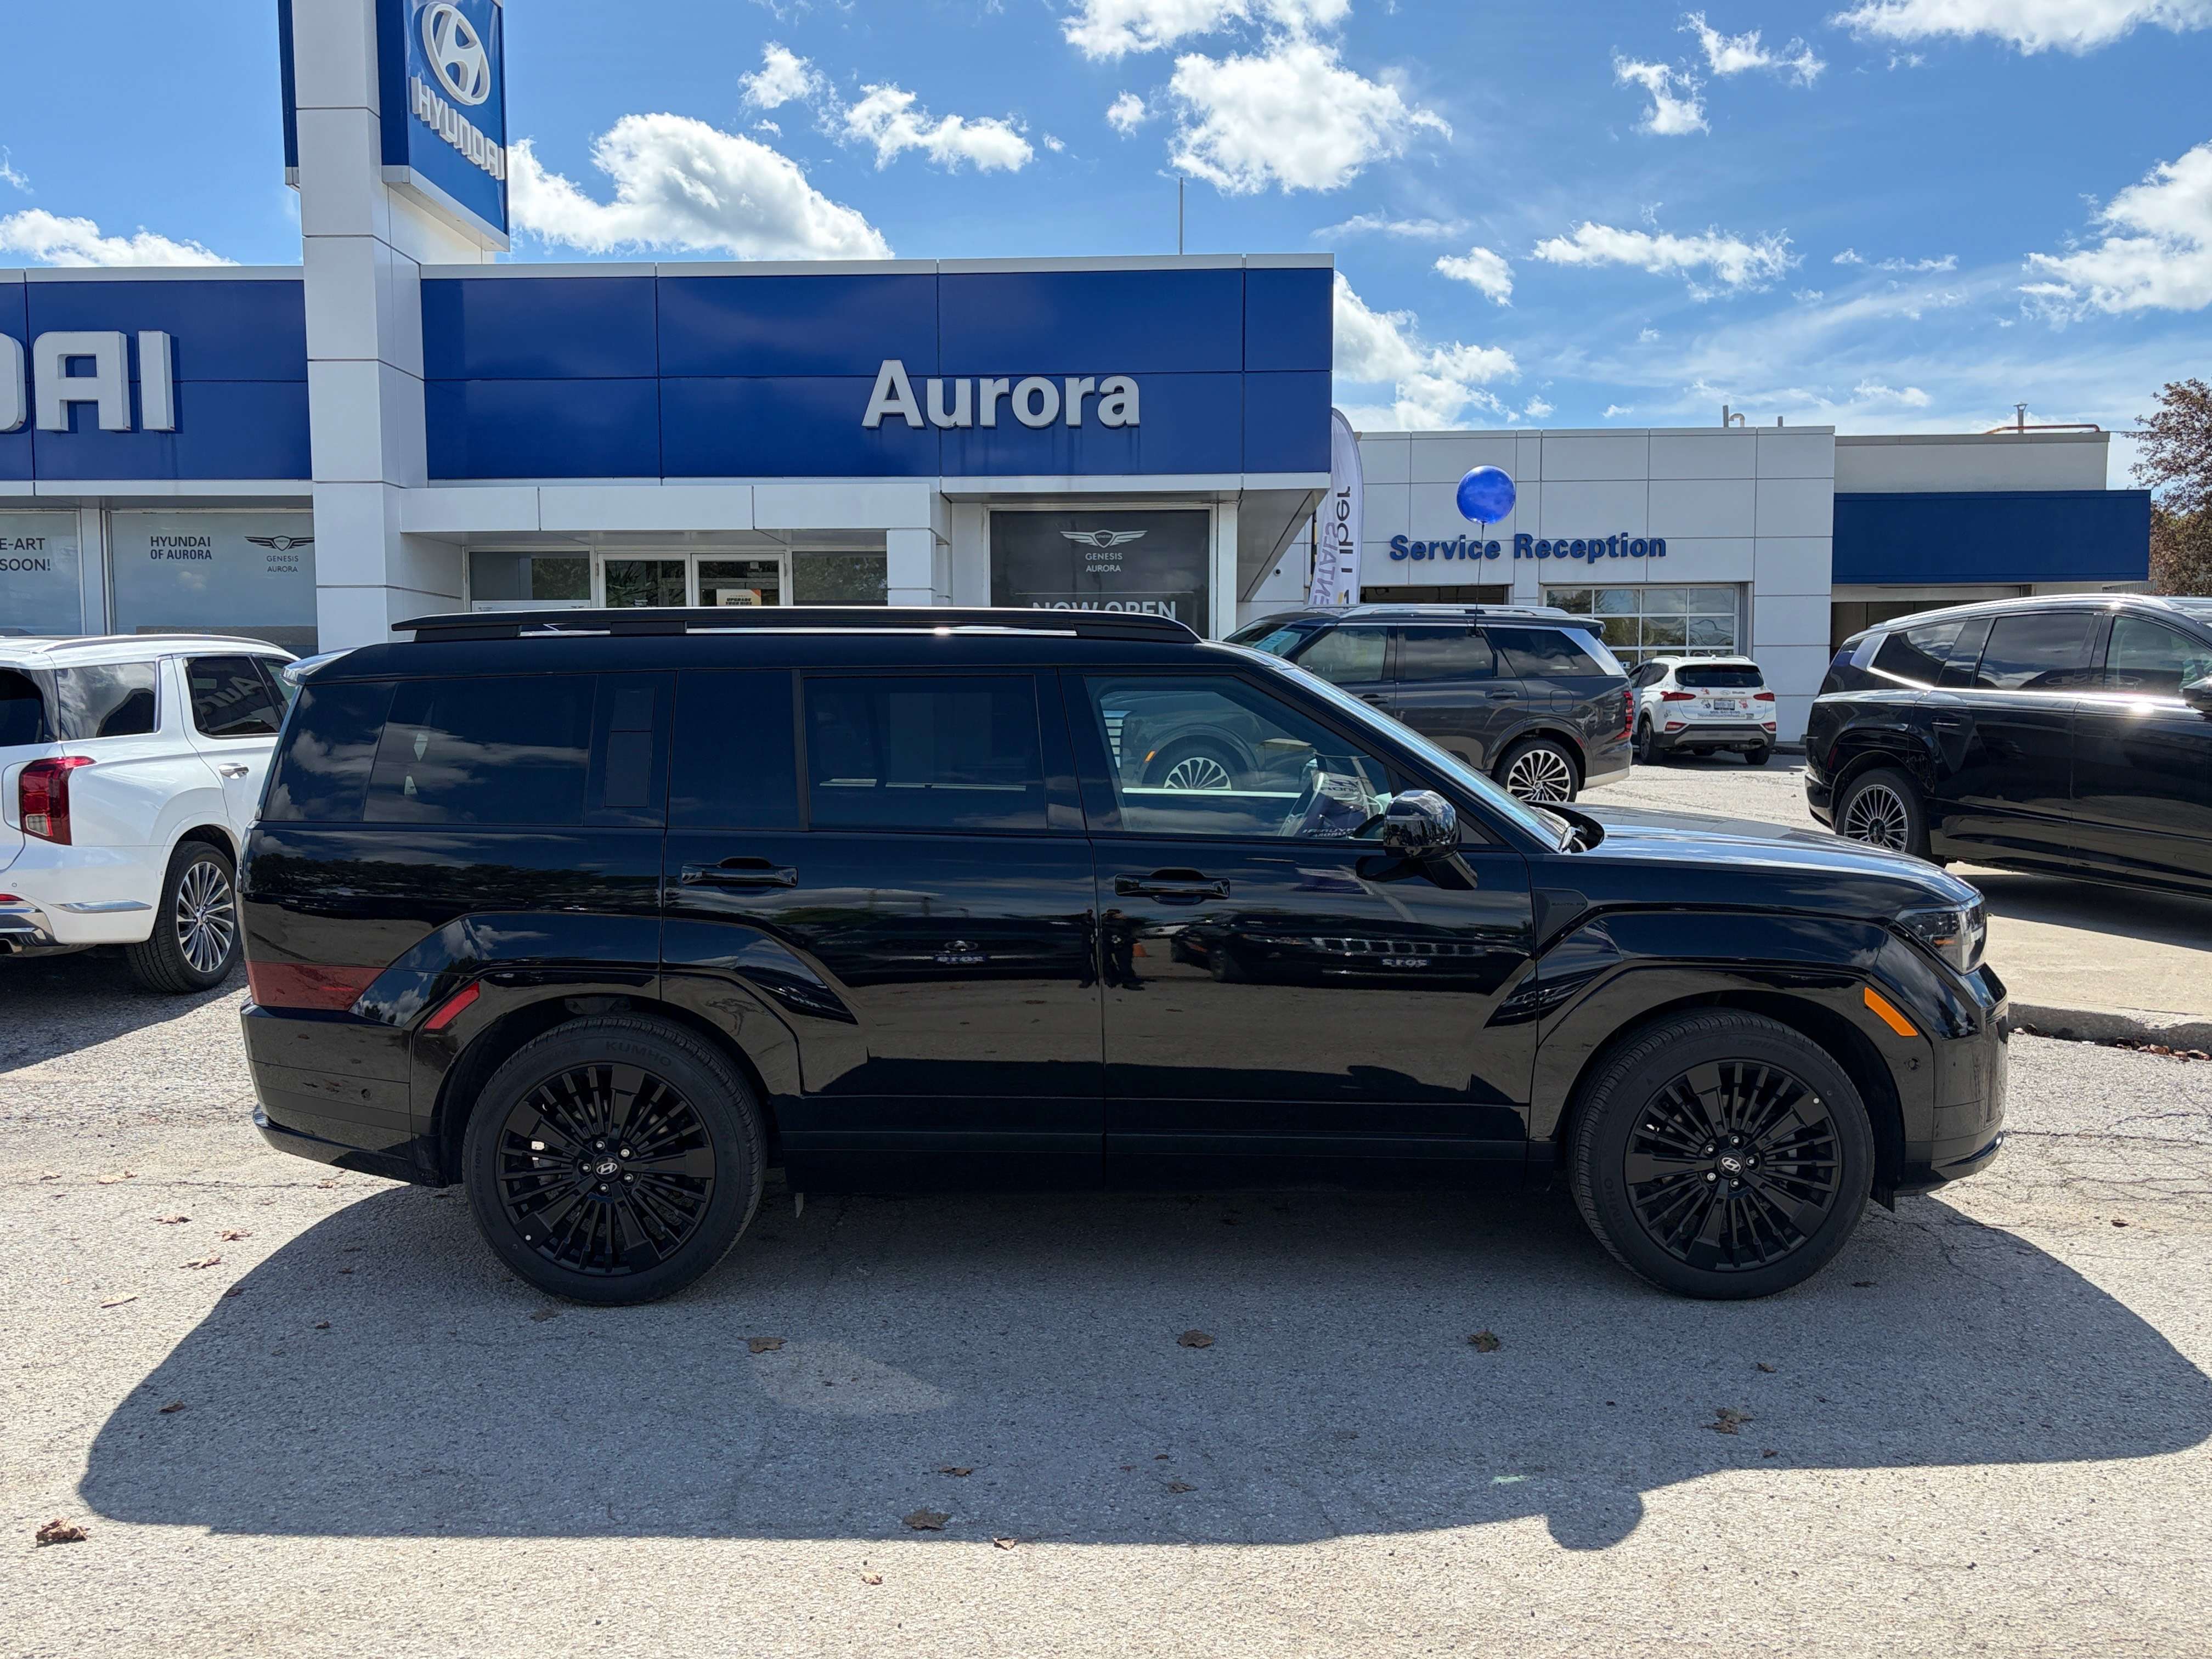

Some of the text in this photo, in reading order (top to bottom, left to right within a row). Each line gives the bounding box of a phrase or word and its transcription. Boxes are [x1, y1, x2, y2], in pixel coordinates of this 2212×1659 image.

[411, 76, 505, 180] HYUNDAI
[861, 360, 1141, 428] Aurora
[150, 536, 211, 547] HYUNDAI
[1390, 532, 1667, 564] Service Reception
[0, 558, 50, 571] SOON!
[150, 549, 212, 560] OF AURORA
[606, 1042, 672, 1066] KUMHO
